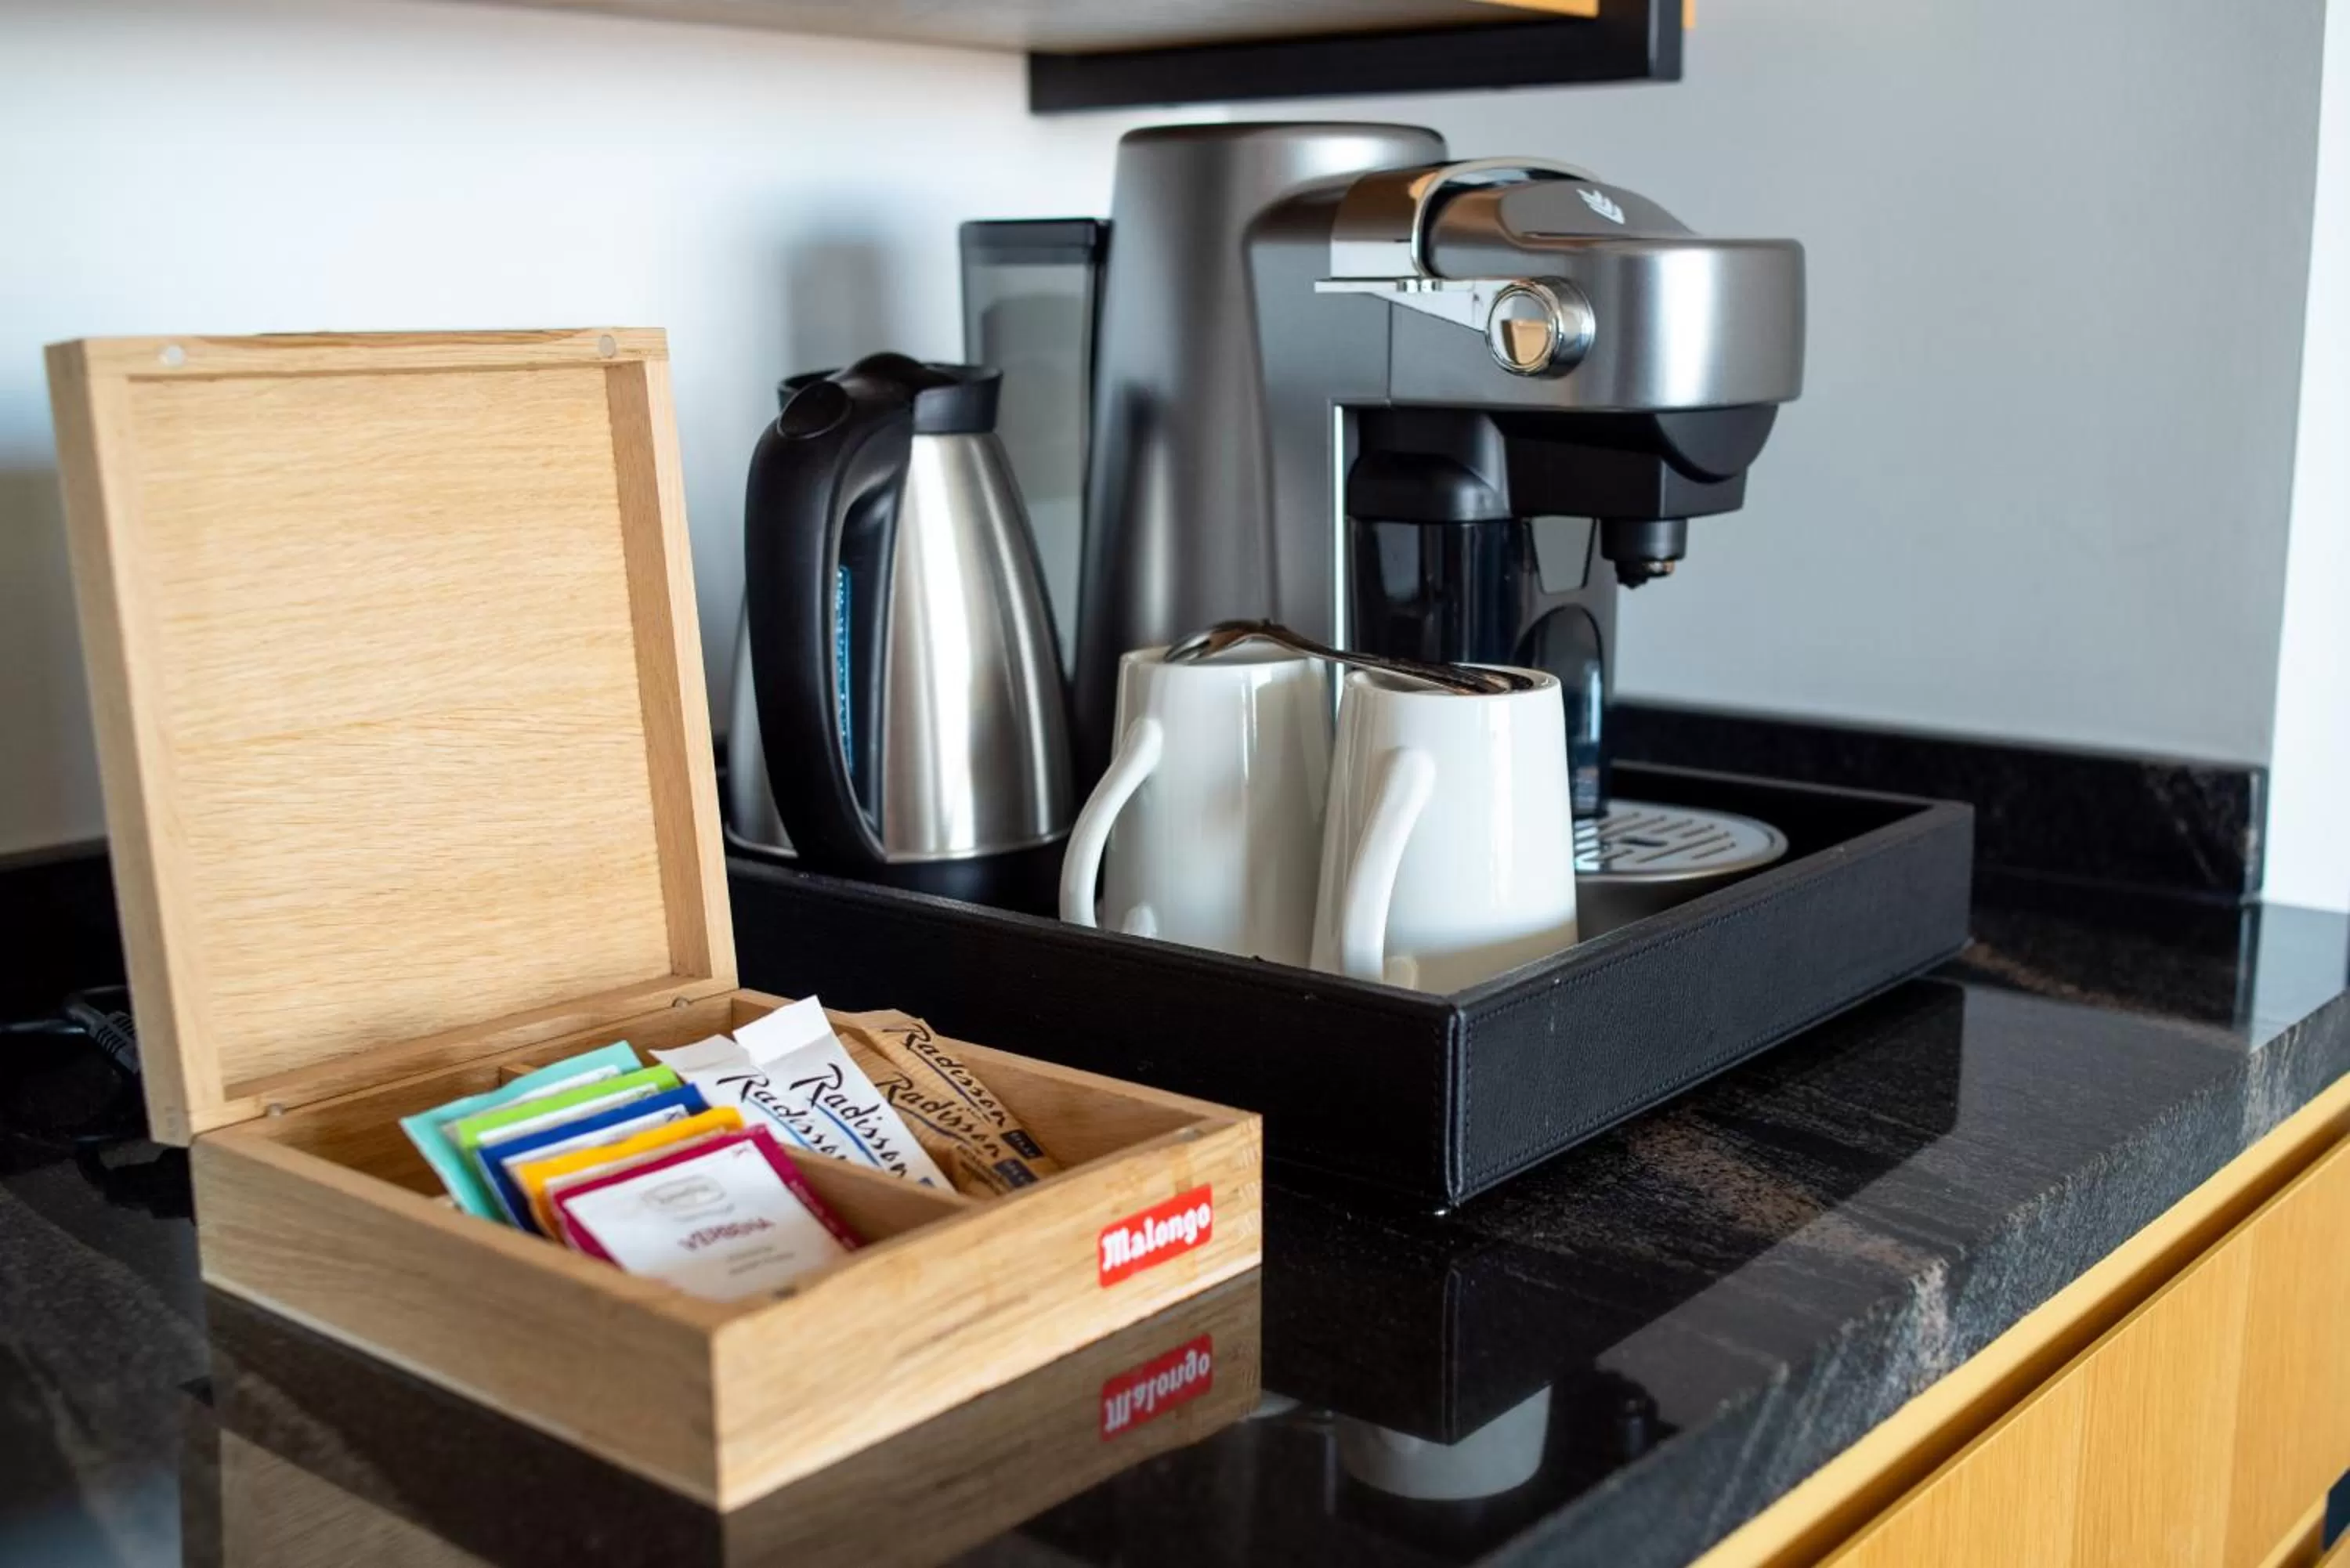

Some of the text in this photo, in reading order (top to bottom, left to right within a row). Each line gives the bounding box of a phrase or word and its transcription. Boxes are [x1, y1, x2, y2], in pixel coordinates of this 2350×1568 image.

[789, 1062, 909, 1179] Radisson
[874, 1071, 1000, 1159] Radisson
[882, 1022, 1007, 1128] Radisson
[1101, 1202, 1211, 1272] Malongo
